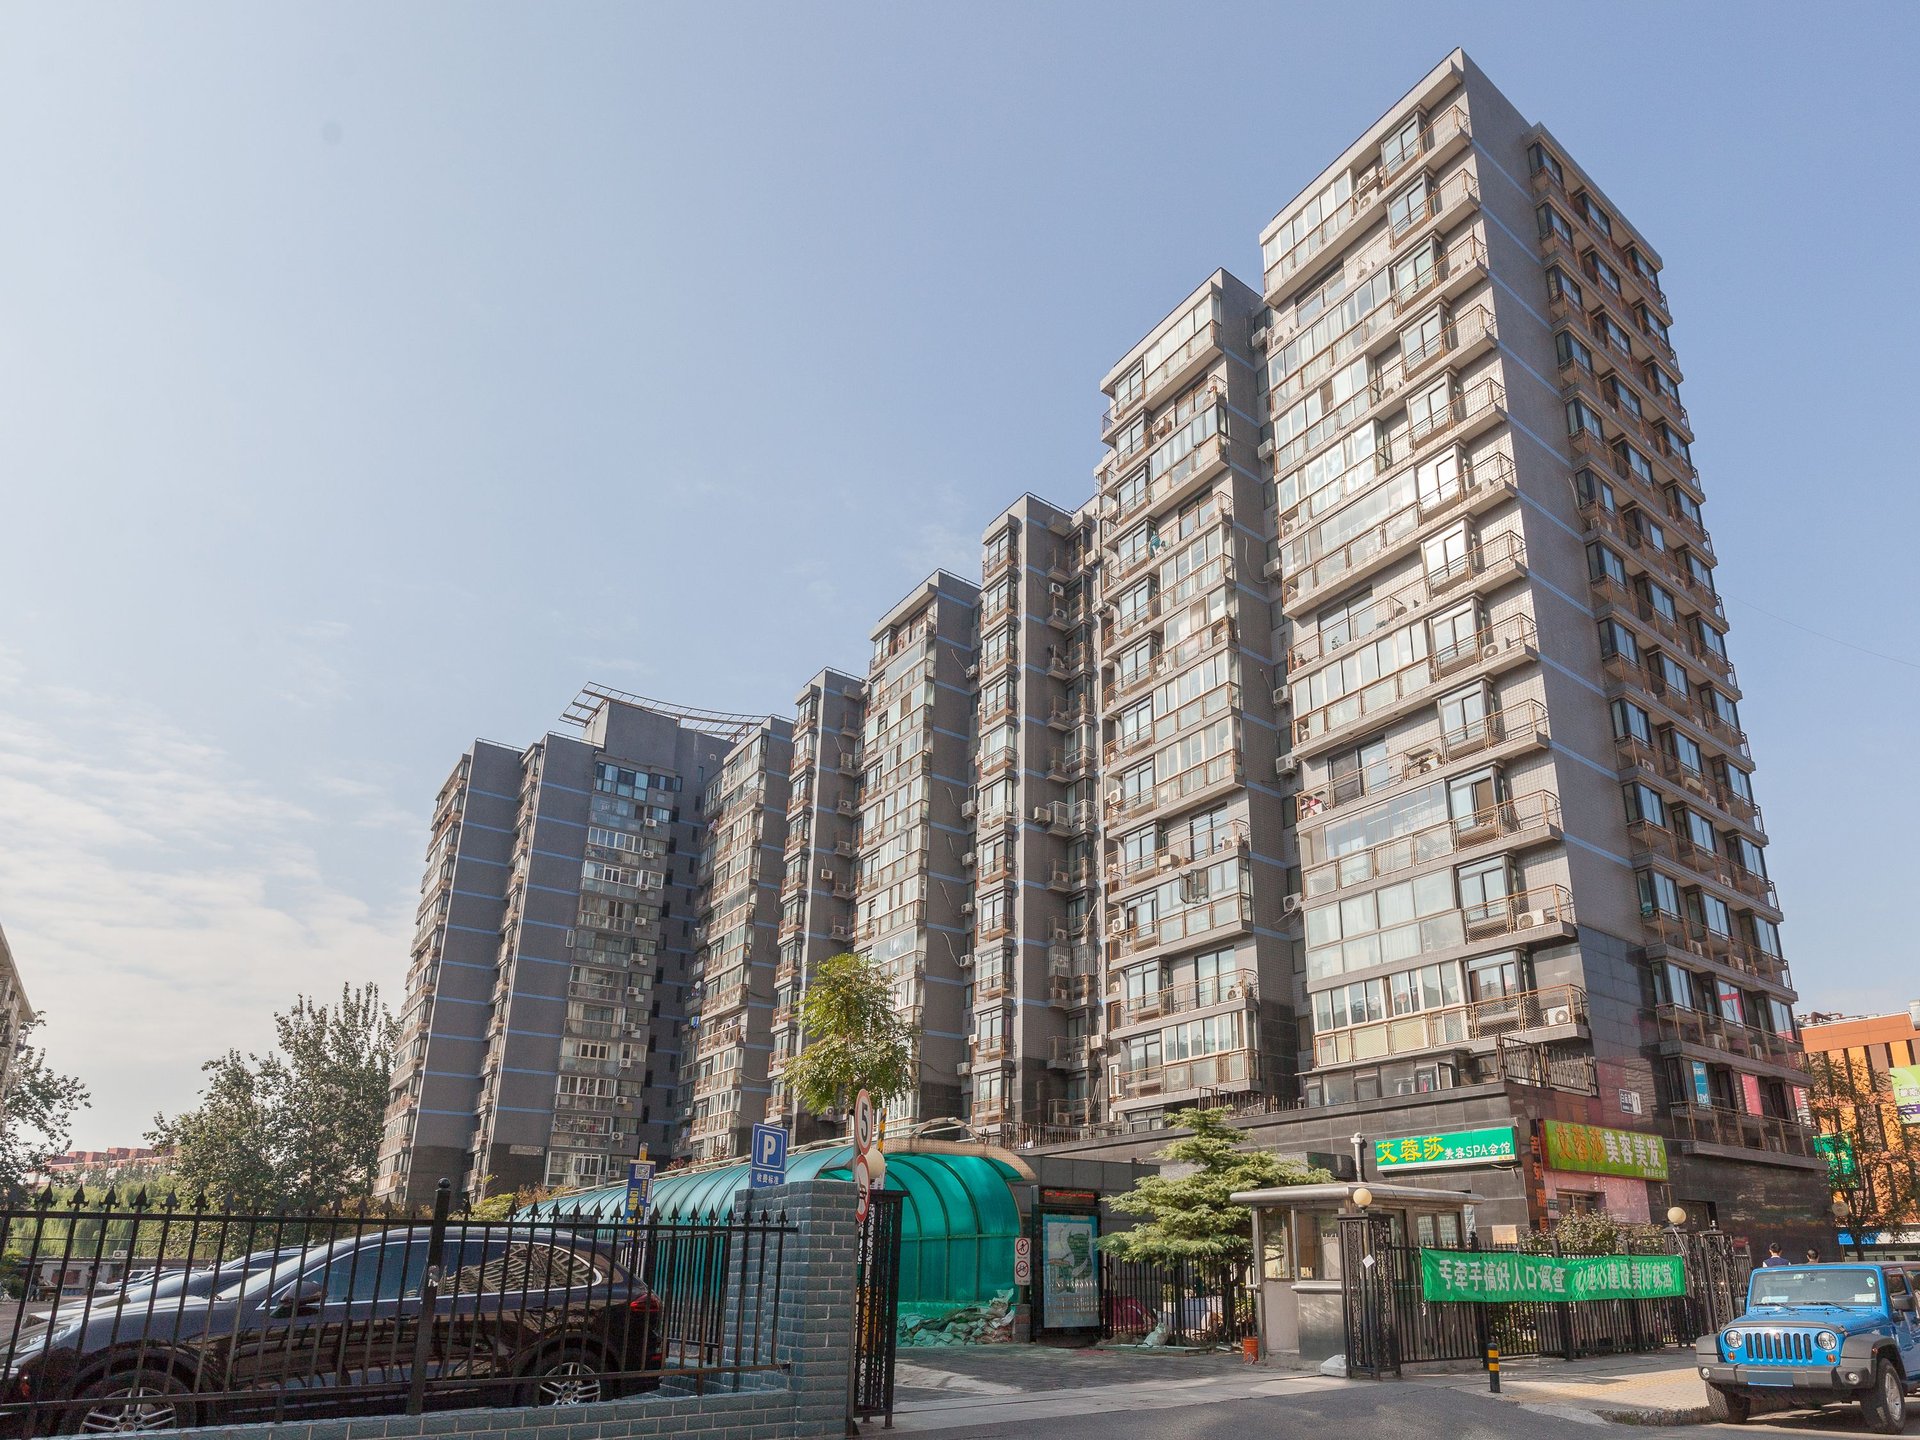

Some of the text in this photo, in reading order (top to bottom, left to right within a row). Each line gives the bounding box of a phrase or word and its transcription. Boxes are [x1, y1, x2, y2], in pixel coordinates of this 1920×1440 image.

[861, 1102, 868, 1143] 5
[762, 1134, 777, 1164] P
[1438, 1259, 1567, 1293] 手牵手搞好人口调查
